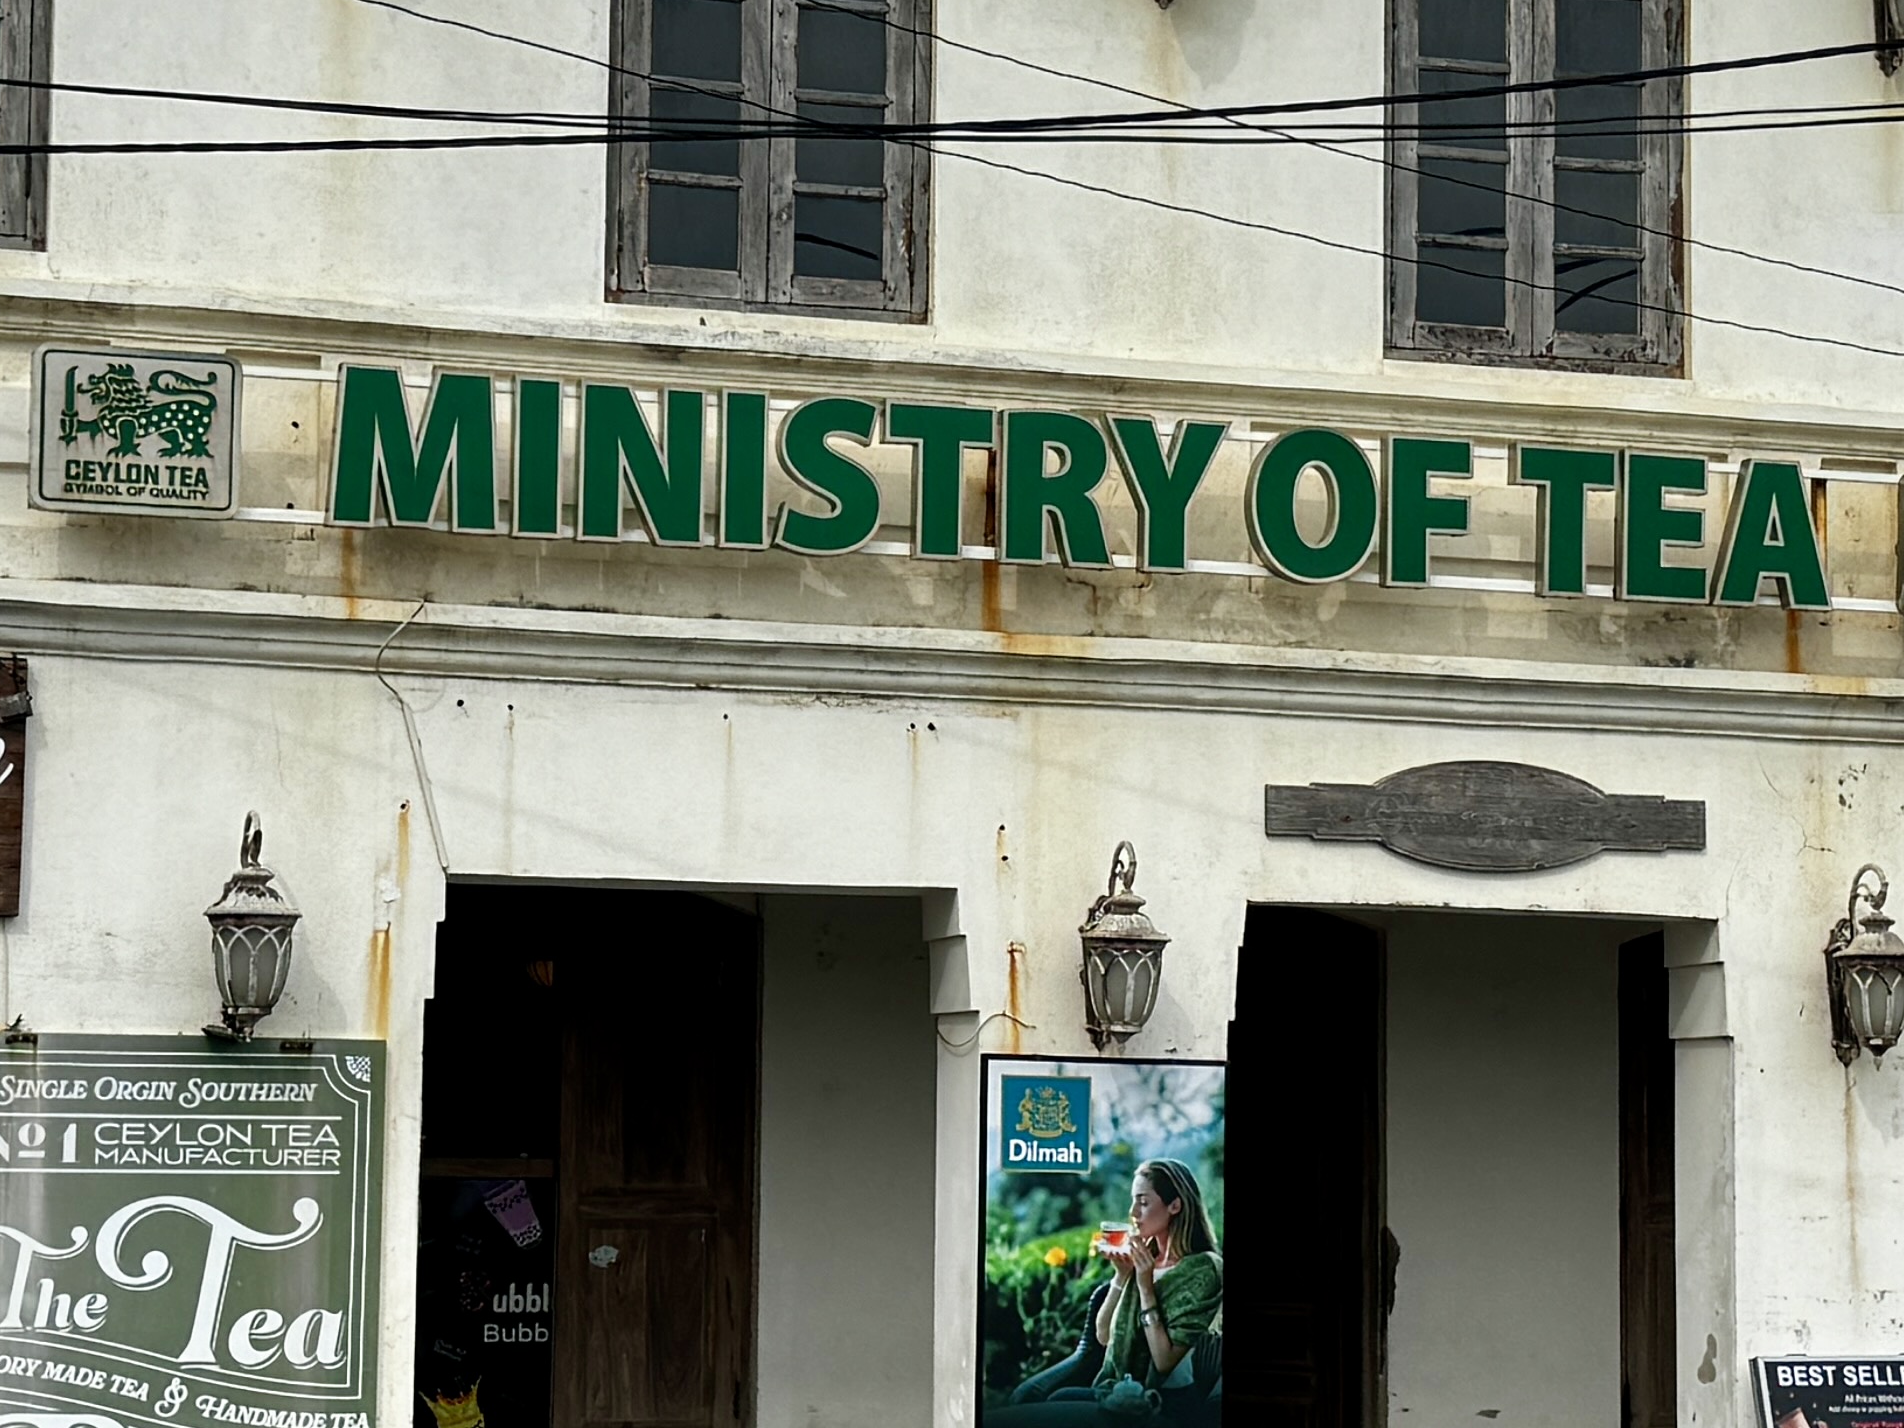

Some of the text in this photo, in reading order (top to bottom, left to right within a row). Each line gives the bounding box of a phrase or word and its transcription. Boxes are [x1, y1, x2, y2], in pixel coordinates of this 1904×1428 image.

[65, 459, 209, 489] CEYLON TEA
[327, 363, 1831, 611] MINISTRY OF TEA
[63, 482, 209, 501] SYMBOL OF QUALITY
[60, 1122, 79, 1163] 1
[94, 1123, 252, 1146] CEYLON
[260, 1124, 340, 1147] TEA
[94, 1147, 340, 1166] MANUFACTURER
[1008, 1138, 1083, 1164] Dilmah
[95, 1195, 347, 1370] Tea
[40, 1357, 107, 1391] MADE
[109, 1374, 150, 1403] TEA
[154, 1377, 188, 1418] &
[1777, 1366, 1836, 1386] BEST
